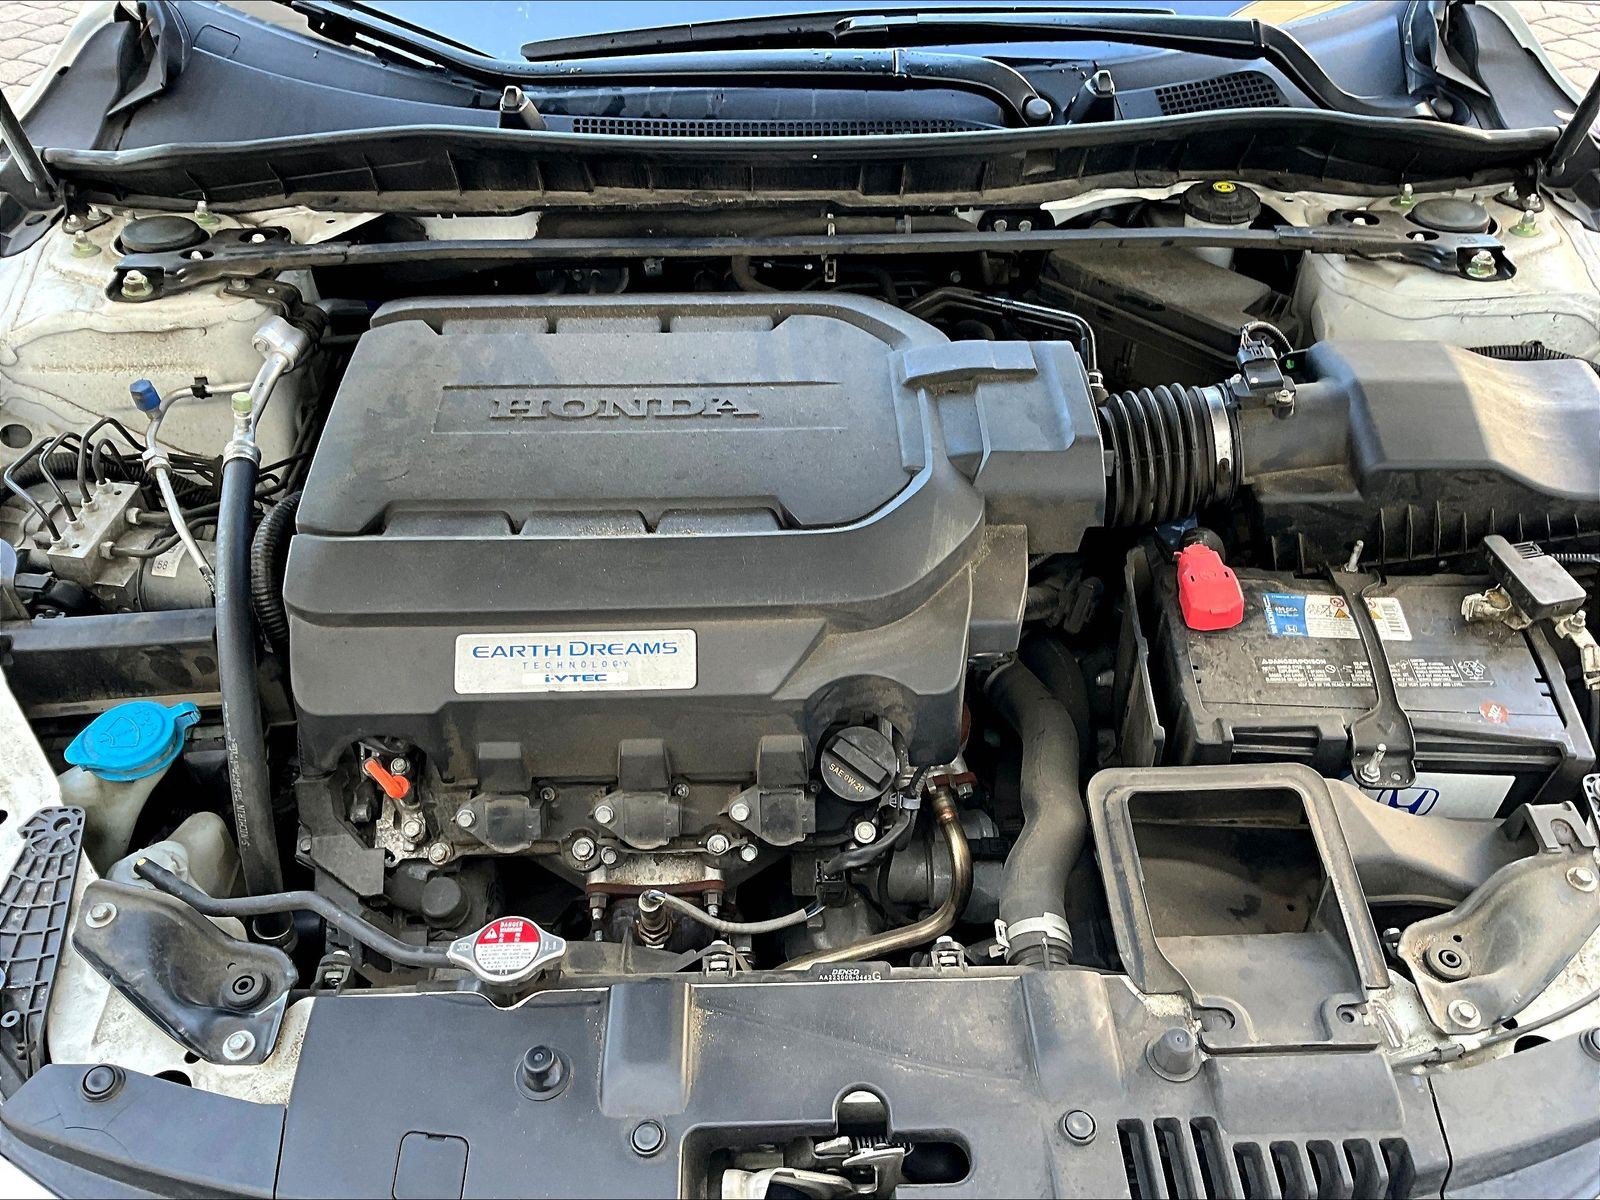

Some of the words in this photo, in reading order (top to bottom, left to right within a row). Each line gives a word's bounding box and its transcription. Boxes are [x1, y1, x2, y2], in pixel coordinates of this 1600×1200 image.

[489, 398, 760, 420] HONDA
[472, 644, 561, 659] EARTH
[569, 641, 678, 656] DREAMS
[522, 660, 629, 670] TECHNOLOGY
[544, 673, 608, 683] i-VTEC
[829, 763, 844, 777] SAE
[843, 773, 865, 793] 0W-20
[500, 920, 524, 928] DANGER
[544, 941, 557, 950] 1.1
